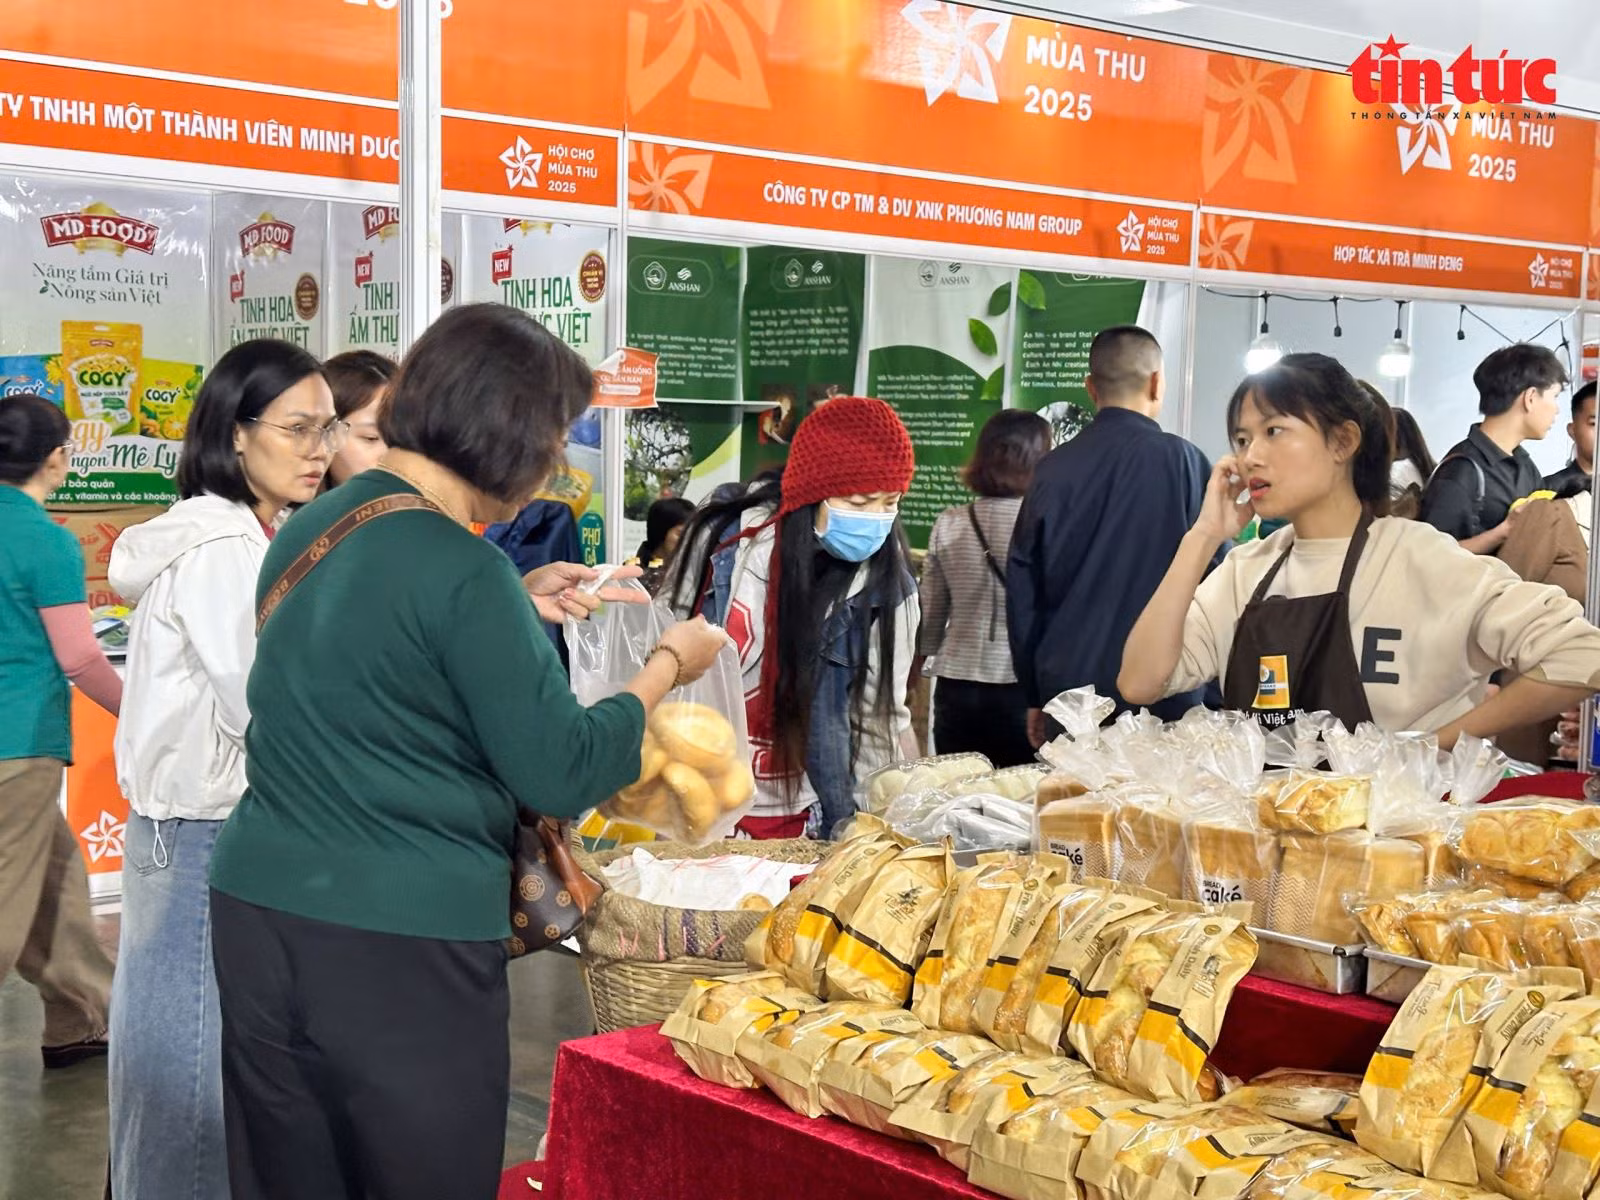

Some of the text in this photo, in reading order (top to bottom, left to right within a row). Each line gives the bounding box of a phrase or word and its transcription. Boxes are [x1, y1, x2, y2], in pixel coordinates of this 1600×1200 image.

[1026, 32, 1146, 82] MÙA THU
[1024, 85, 1093, 122] 2025
[29, 96, 95, 126] TNHH
[103, 102, 155, 133] MỘT
[160, 110, 238, 142] THÀNH
[244, 119, 293, 148] VIÊN
[300, 127, 355, 155] MINH
[1471, 109, 1555, 148] MÙA THU
[547, 144, 595, 163] HỘI CHỢ
[547, 161, 598, 178] MÙA THU
[1468, 153, 1517, 182] 2025
[547, 180, 577, 193] 2025
[368, 208, 384, 230] MD
[763, 180, 1083, 236] CÔNG TY CP TM & DV XNK PHƯƠNG NAM GROUP
[52, 218, 147, 243] MD FOOD
[261, 225, 289, 245] FOOD
[1165, 232, 1180, 243] THU
[1146, 245, 1165, 255] 2025
[1334, 245, 1356, 264] HỢP
[1357, 246, 1375, 264] TÁC
[1377, 247, 1391, 266] XÃ
[1392, 249, 1411, 267] TRÀ
[1412, 252, 1437, 270] MINH
[33, 262, 168, 289] Nâng tầm Giá trị
[356, 263, 370, 276] NEW
[494, 259, 510, 273] NEW
[668, 282, 701, 293] ANSHAN
[939, 275, 970, 285] ANSHAN
[51, 283, 160, 306] Nông sản Việt
[363, 282, 393, 311] TINH
[502, 278, 536, 309] TINH
[541, 276, 573, 308] HOA
[240, 297, 266, 323] TINH
[269, 295, 295, 322] HOA
[557, 307, 591, 348] VIỆT
[79, 370, 126, 387] COGY
[145, 388, 177, 403] COGY
[73, 422, 106, 451] gy
[71, 444, 178, 475] ngon Mê Ly
[68, 479, 88, 488] bảo
[90, 479, 115, 489] quản
[75, 492, 109, 500] vitamin
[111, 492, 122, 500] và
[124, 491, 141, 500] các
[143, 492, 177, 503] khoáng
[1361, 626, 1402, 685] E
[1262, 712, 1287, 726] Việt
[1287, 708, 1305, 720] am
